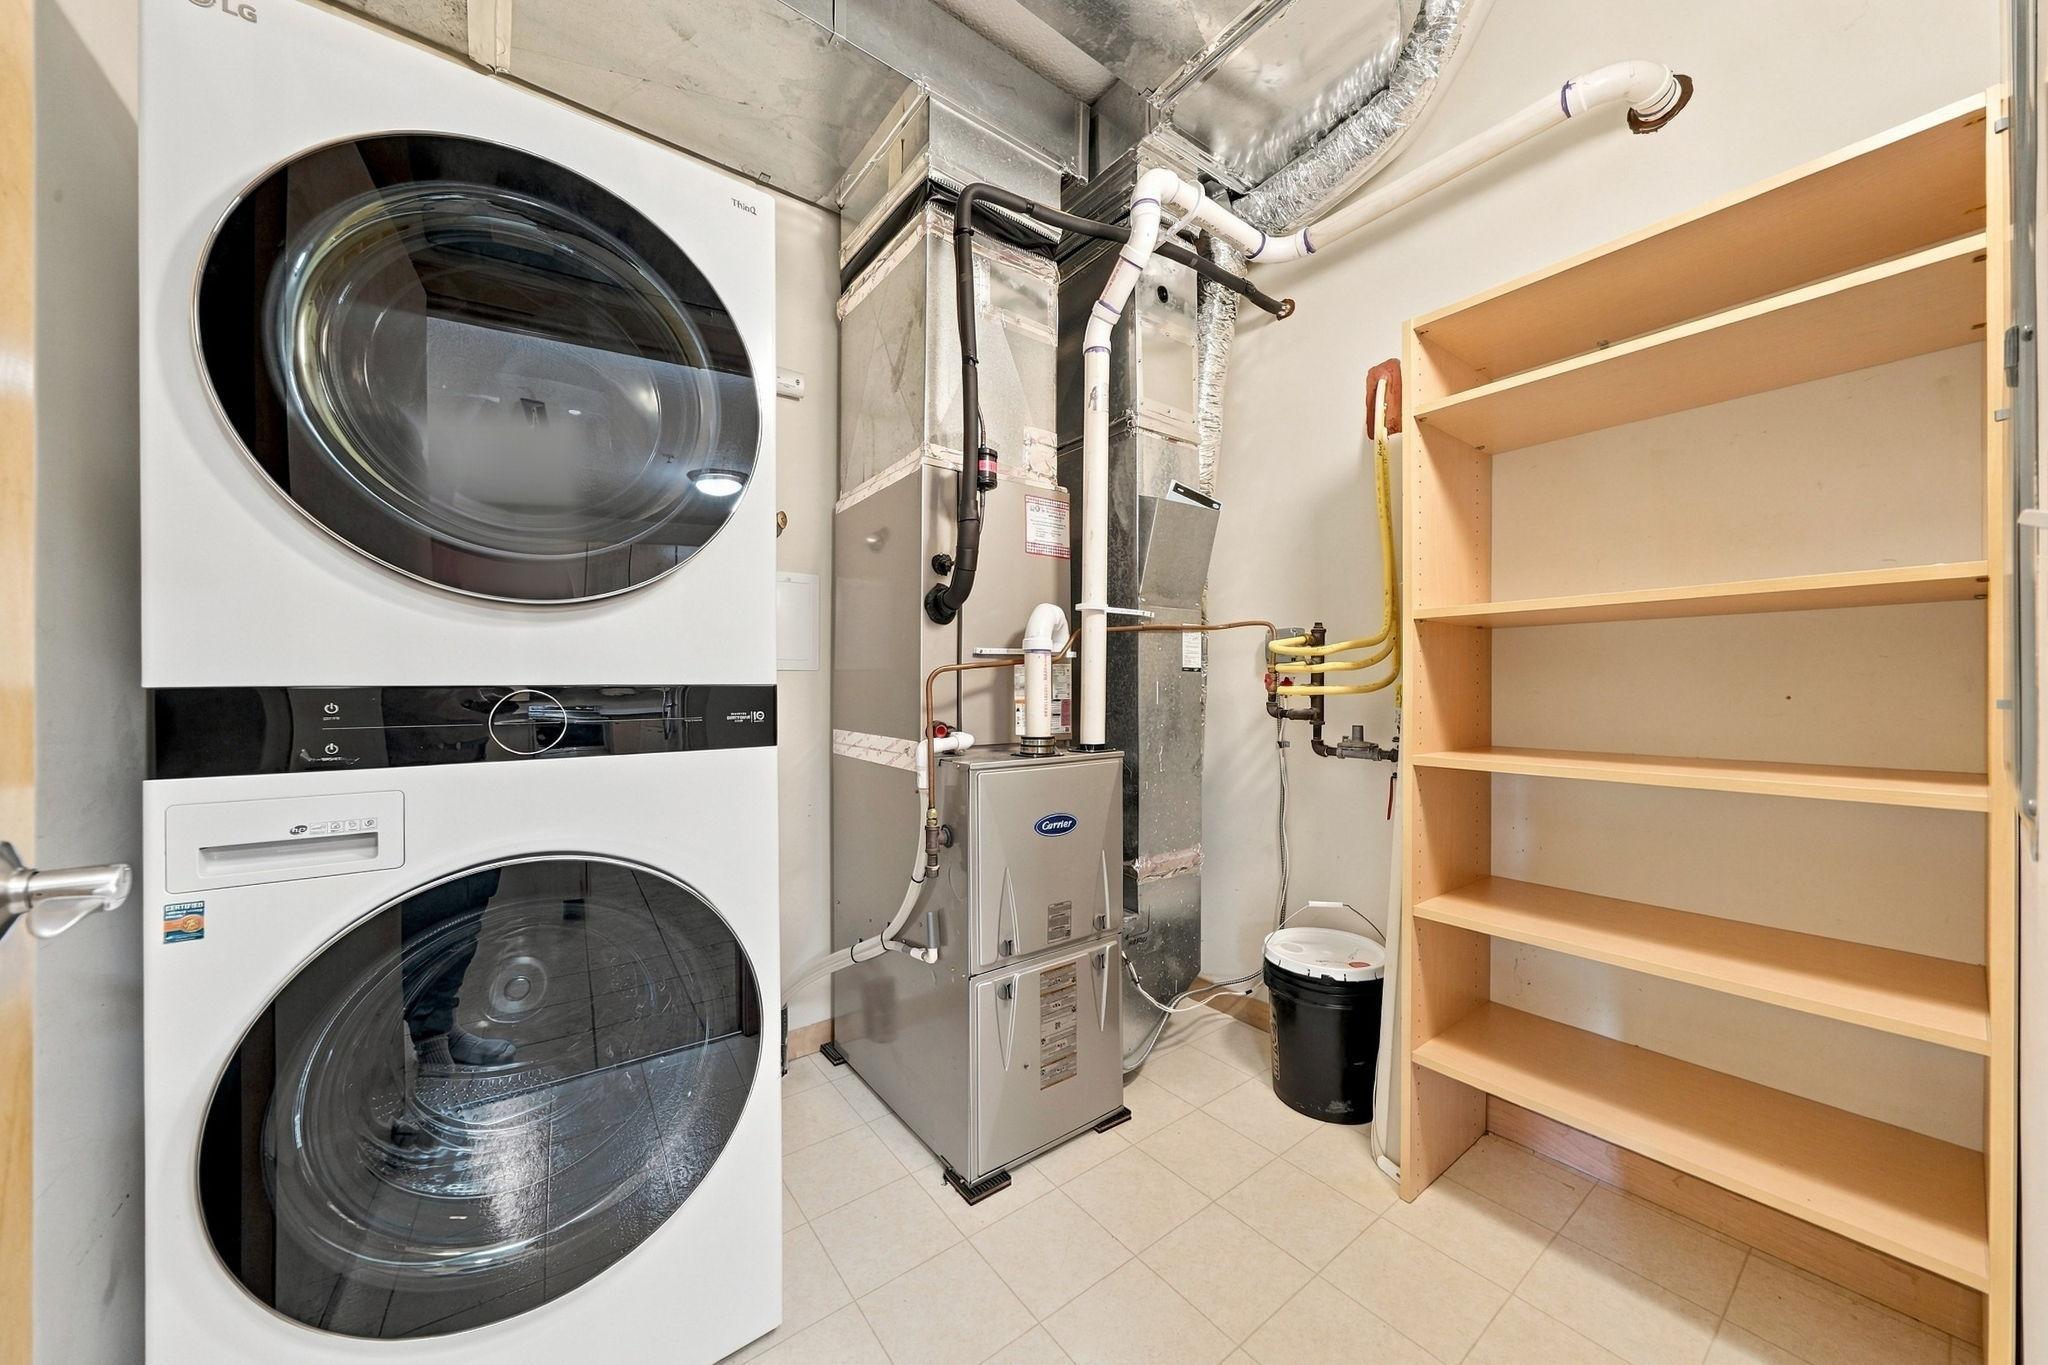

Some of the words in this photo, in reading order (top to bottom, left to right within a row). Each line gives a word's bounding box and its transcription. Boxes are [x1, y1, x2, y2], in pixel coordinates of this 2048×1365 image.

[222, 0, 258, 23] LG
[730, 197, 757, 216] ThinQ
[1041, 820, 1073, 831] Carrier
